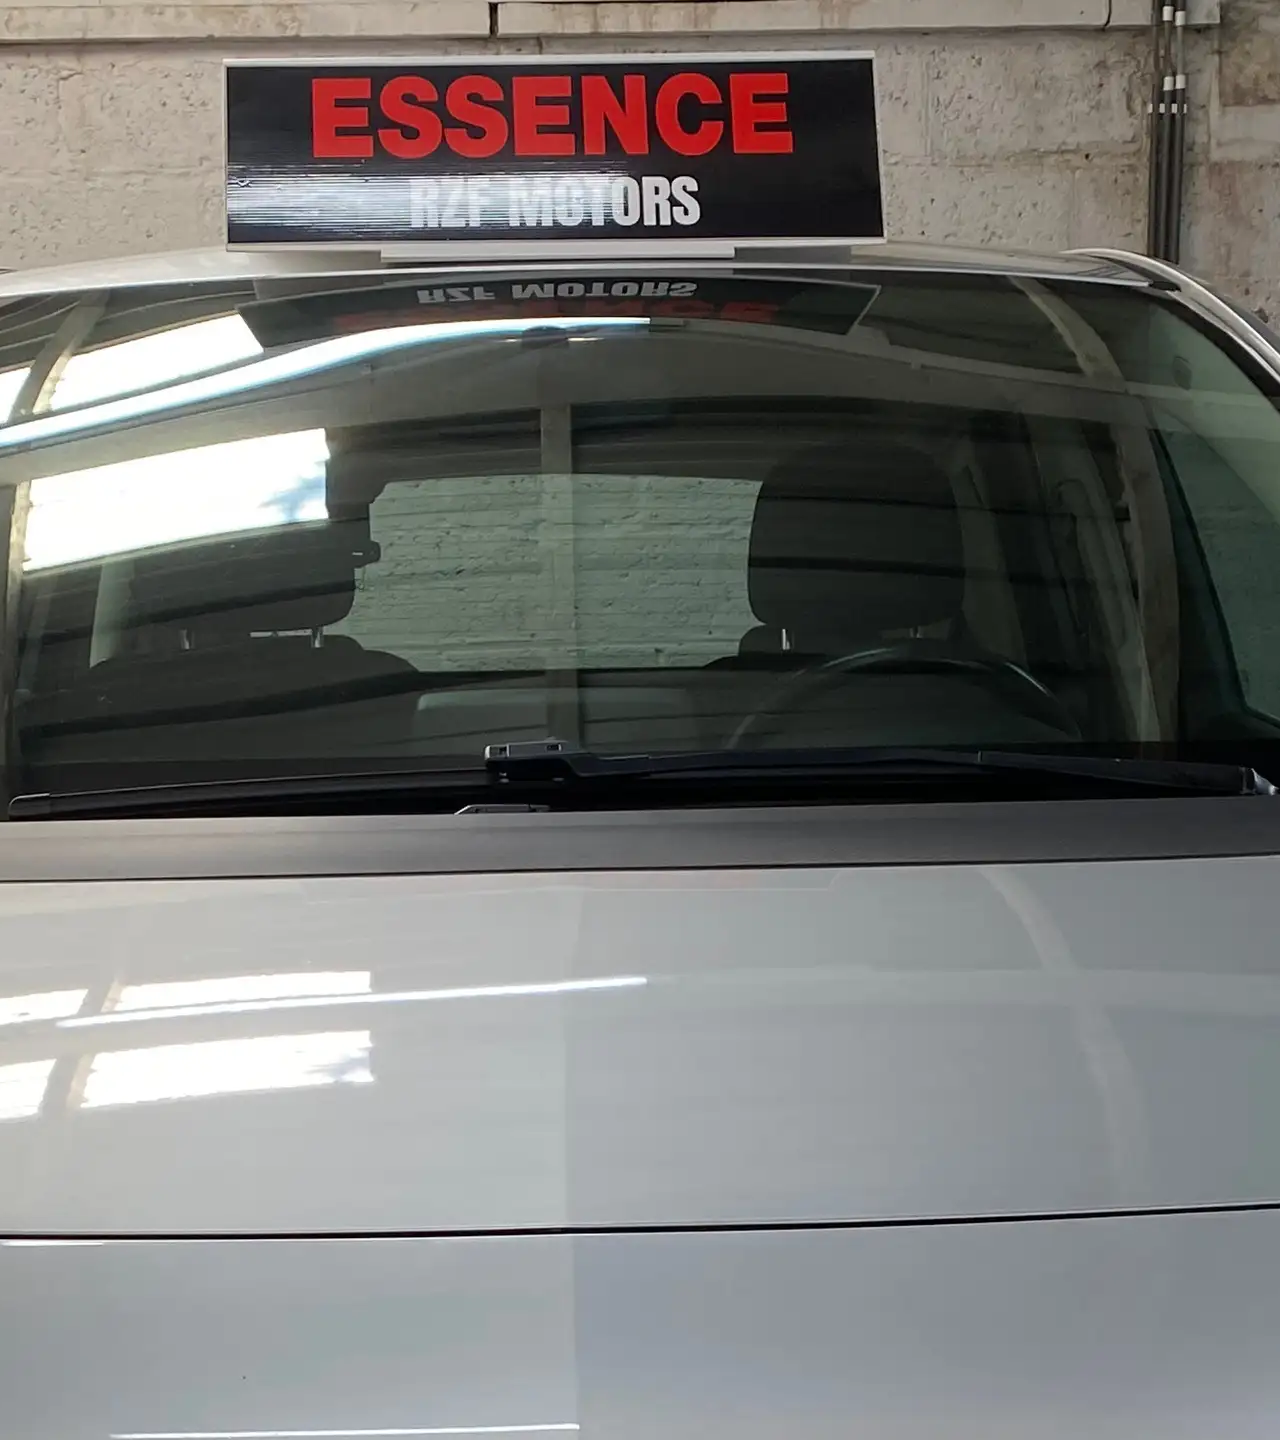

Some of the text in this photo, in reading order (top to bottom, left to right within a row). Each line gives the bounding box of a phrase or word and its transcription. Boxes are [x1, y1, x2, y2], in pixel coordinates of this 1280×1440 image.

[311, 72, 795, 159] ESSENCE
[410, 175, 701, 228] RZF MOTORS
